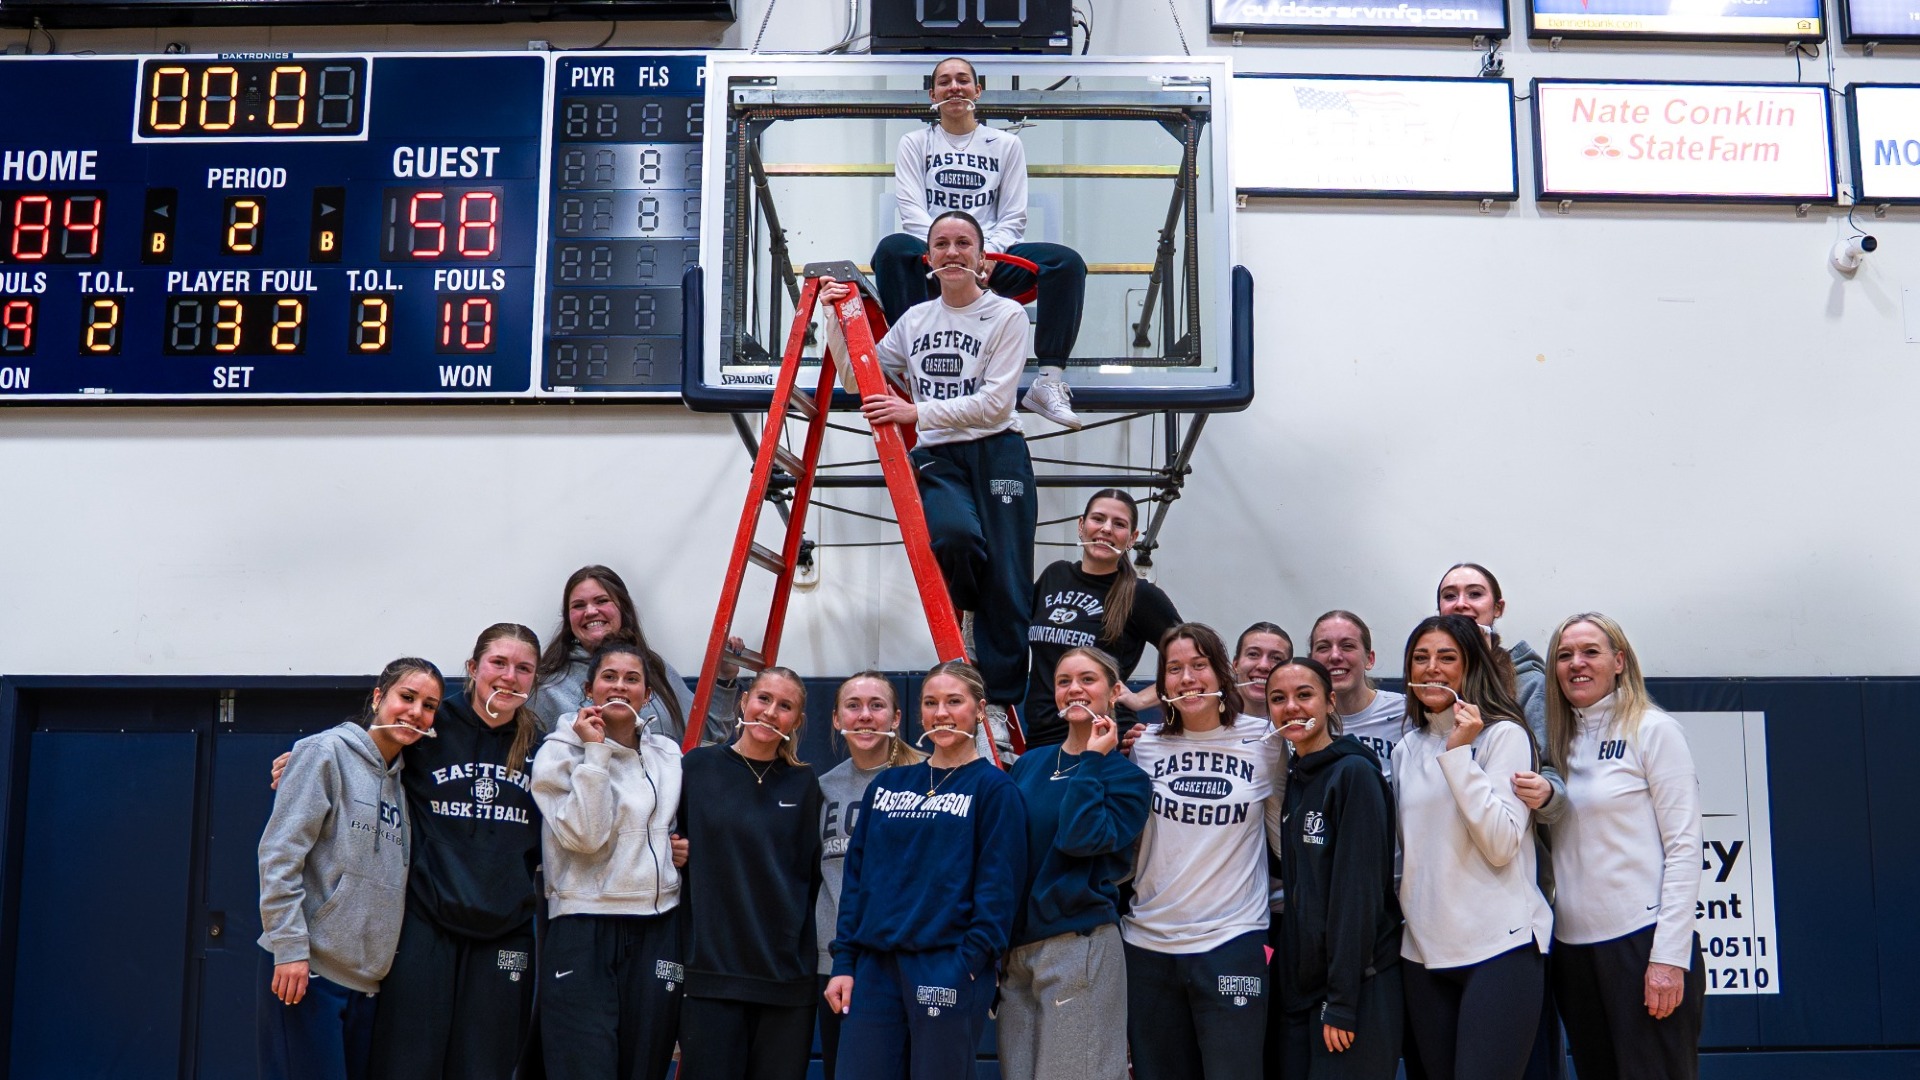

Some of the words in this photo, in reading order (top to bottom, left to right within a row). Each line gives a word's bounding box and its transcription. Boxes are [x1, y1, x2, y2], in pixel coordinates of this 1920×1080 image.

[1241, 0, 1479, 24] outdoorsrvmfg.com
[1548, 18, 1643, 31] bannerbank.com
[571, 66, 615, 87] PLYR
[638, 66, 669, 87] FLS
[1571, 97, 1649, 124] Nate
[1663, 98, 1795, 127] Conklin
[2, 150, 98, 181] HOME
[392, 147, 500, 178] GUEST
[926, 152, 999, 173] EASTERN
[207, 167, 287, 188] PERIOD
[939, 172, 982, 187] BASKETBALL
[926, 189, 998, 209] OREGON
[12, 195, 101, 259] 84
[227, 200, 260, 251] 2
[410, 191, 497, 258] 58
[152, 233, 165, 252] B
[321, 231, 334, 251] B
[79, 272, 134, 293] T.O.L.
[167, 271, 250, 292] PLAYER
[261, 270, 317, 291] FOUL
[347, 270, 403, 290] T.O.L.
[434, 269, 505, 290] FOULS
[3, 301, 33, 348] 9
[86, 300, 118, 351] 2
[215, 300, 242, 350] 3
[271, 299, 302, 350] 2
[359, 299, 388, 349] 3
[442, 298, 492, 349] 10
[910, 330, 982, 359] EASTERN
[212, 366, 254, 388] SET
[439, 365, 492, 387] WON
[924, 357, 962, 373] BASKETBA
[721, 374, 773, 386] SPALDING
[912, 375, 977, 400] REGN
[1044, 590, 1104, 616] EASTERN
[1028, 625, 1097, 647] OUNTAINEERS
[1597, 740, 1627, 760] EOU
[432, 762, 532, 793] EASTERN
[1154, 751, 1254, 783] EASTERN
[1173, 780, 1227, 797] BASKETBALL
[430, 800, 529, 824] BASKETBALL
[873, 786, 926, 812] EASTERN
[920, 792, 973, 818] OREGON
[1151, 791, 1250, 826] OREGON
[887, 811, 938, 819] UNIVERSITY
[351, 820, 404, 847] BASKETB
